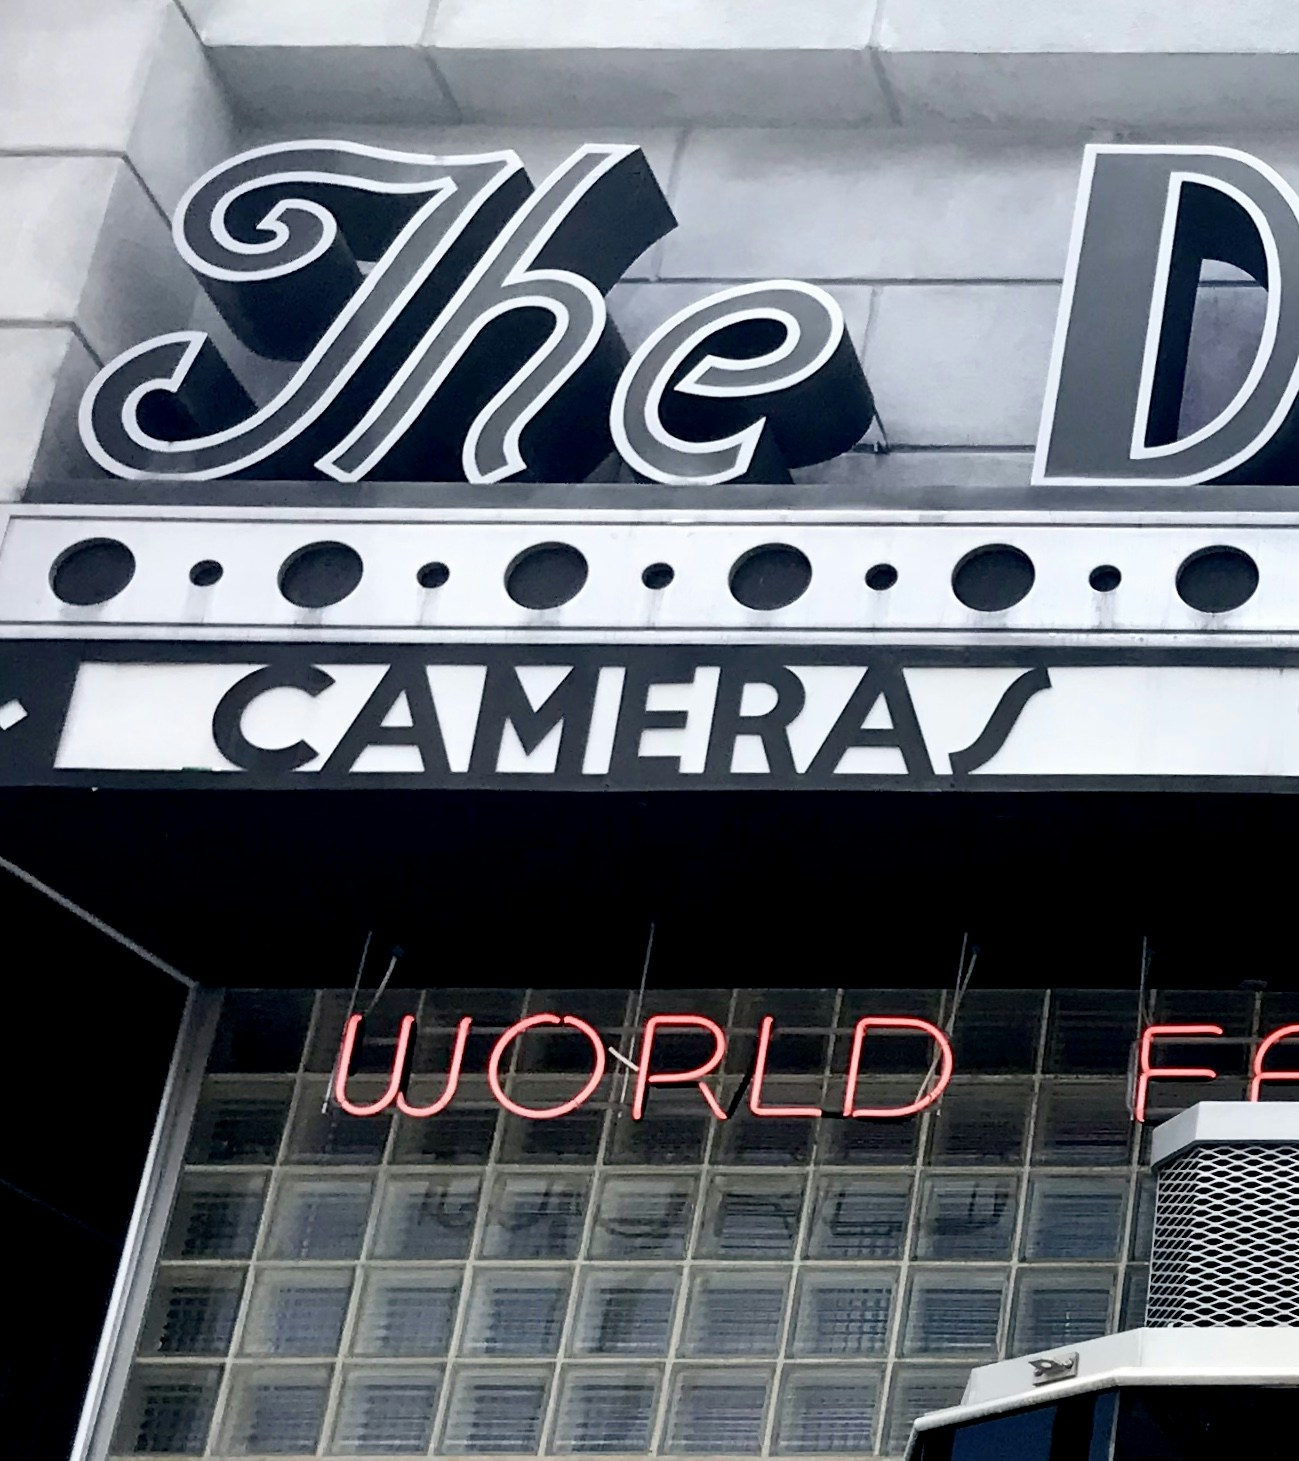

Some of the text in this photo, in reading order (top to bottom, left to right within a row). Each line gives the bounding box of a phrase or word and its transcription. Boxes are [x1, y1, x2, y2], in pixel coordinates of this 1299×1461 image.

[78, 138, 846, 484] The
[212, 663, 1052, 775] CAMERAS
[333, 1014, 954, 1121] WORLD
